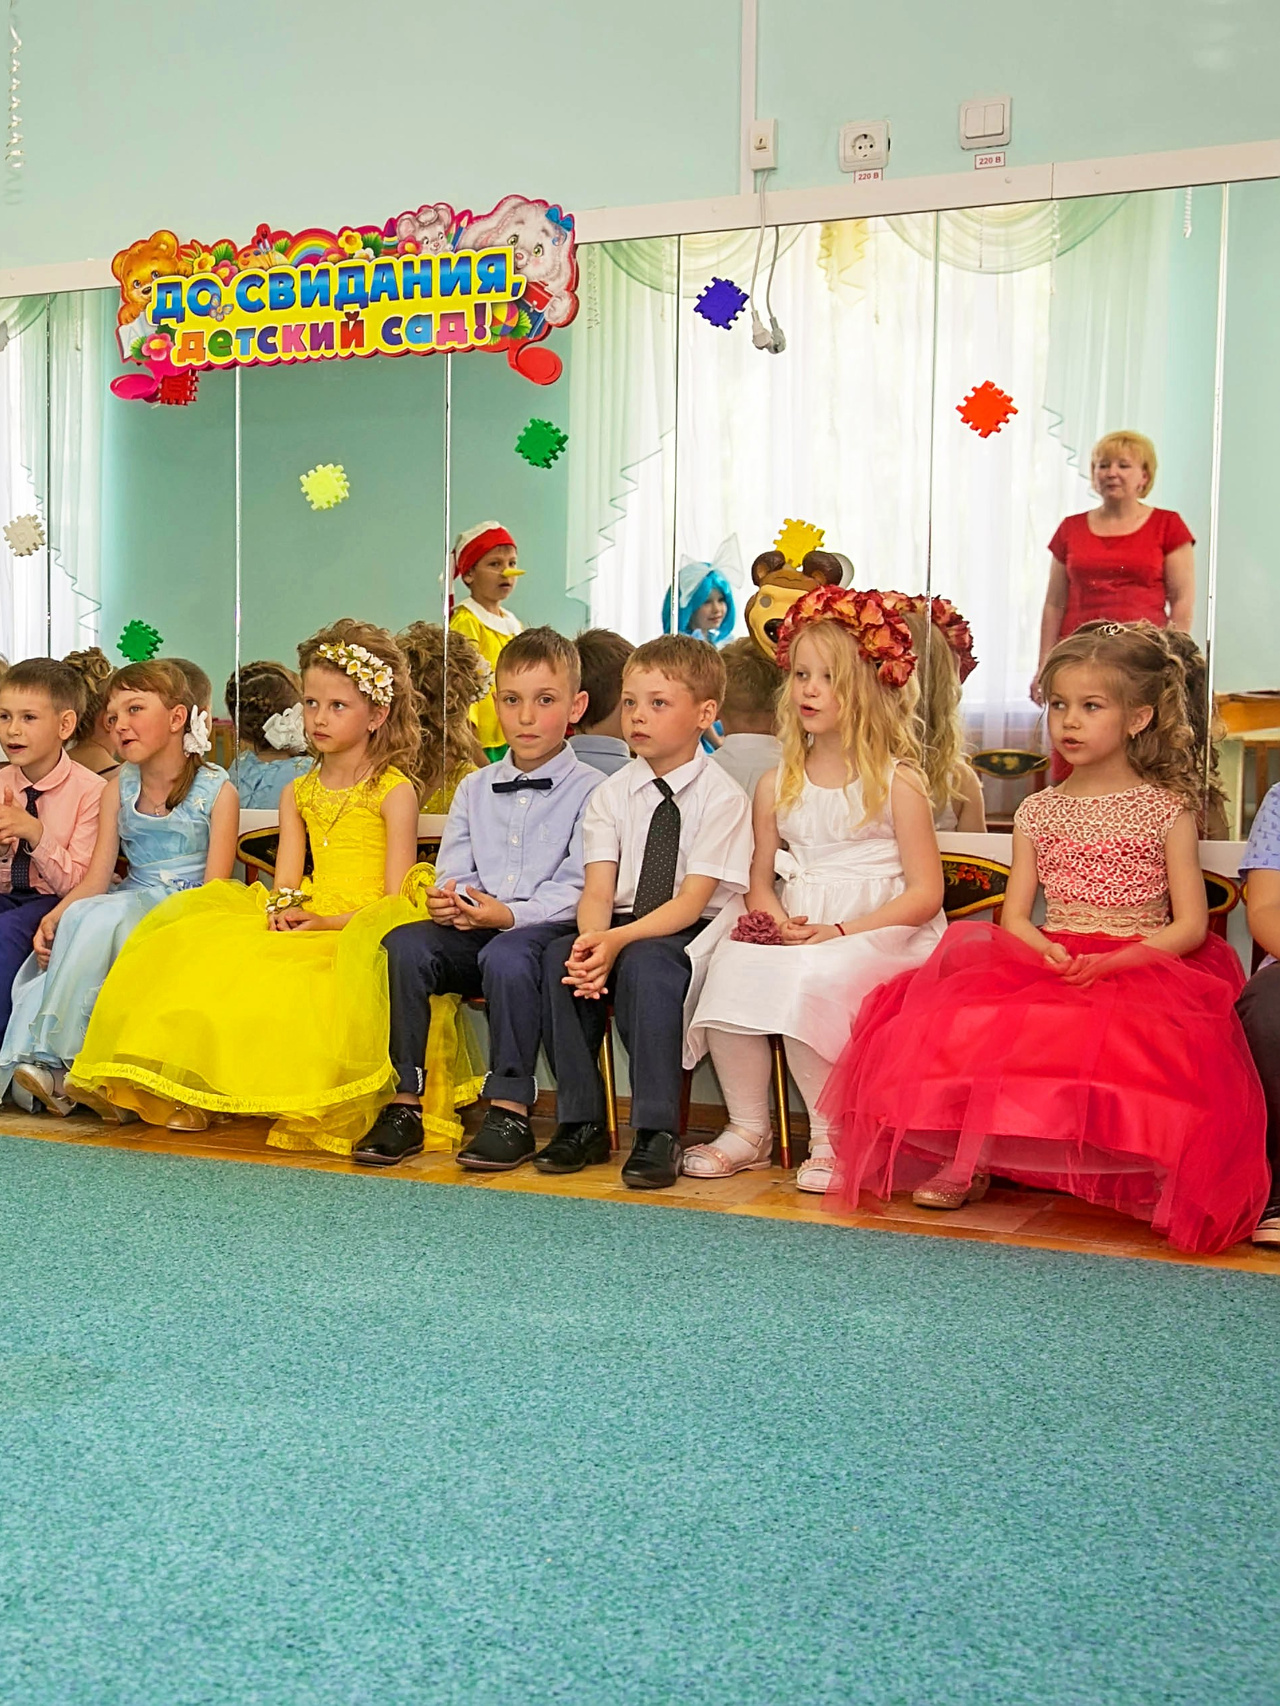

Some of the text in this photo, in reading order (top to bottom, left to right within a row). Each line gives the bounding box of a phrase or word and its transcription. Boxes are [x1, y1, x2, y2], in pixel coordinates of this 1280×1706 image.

[858, 173, 871, 181] 220
[978, 157, 993, 165] 220
[152, 253, 523, 325] ДО СВИДАНИЯ,
[177, 302, 488, 363] детский сад!
